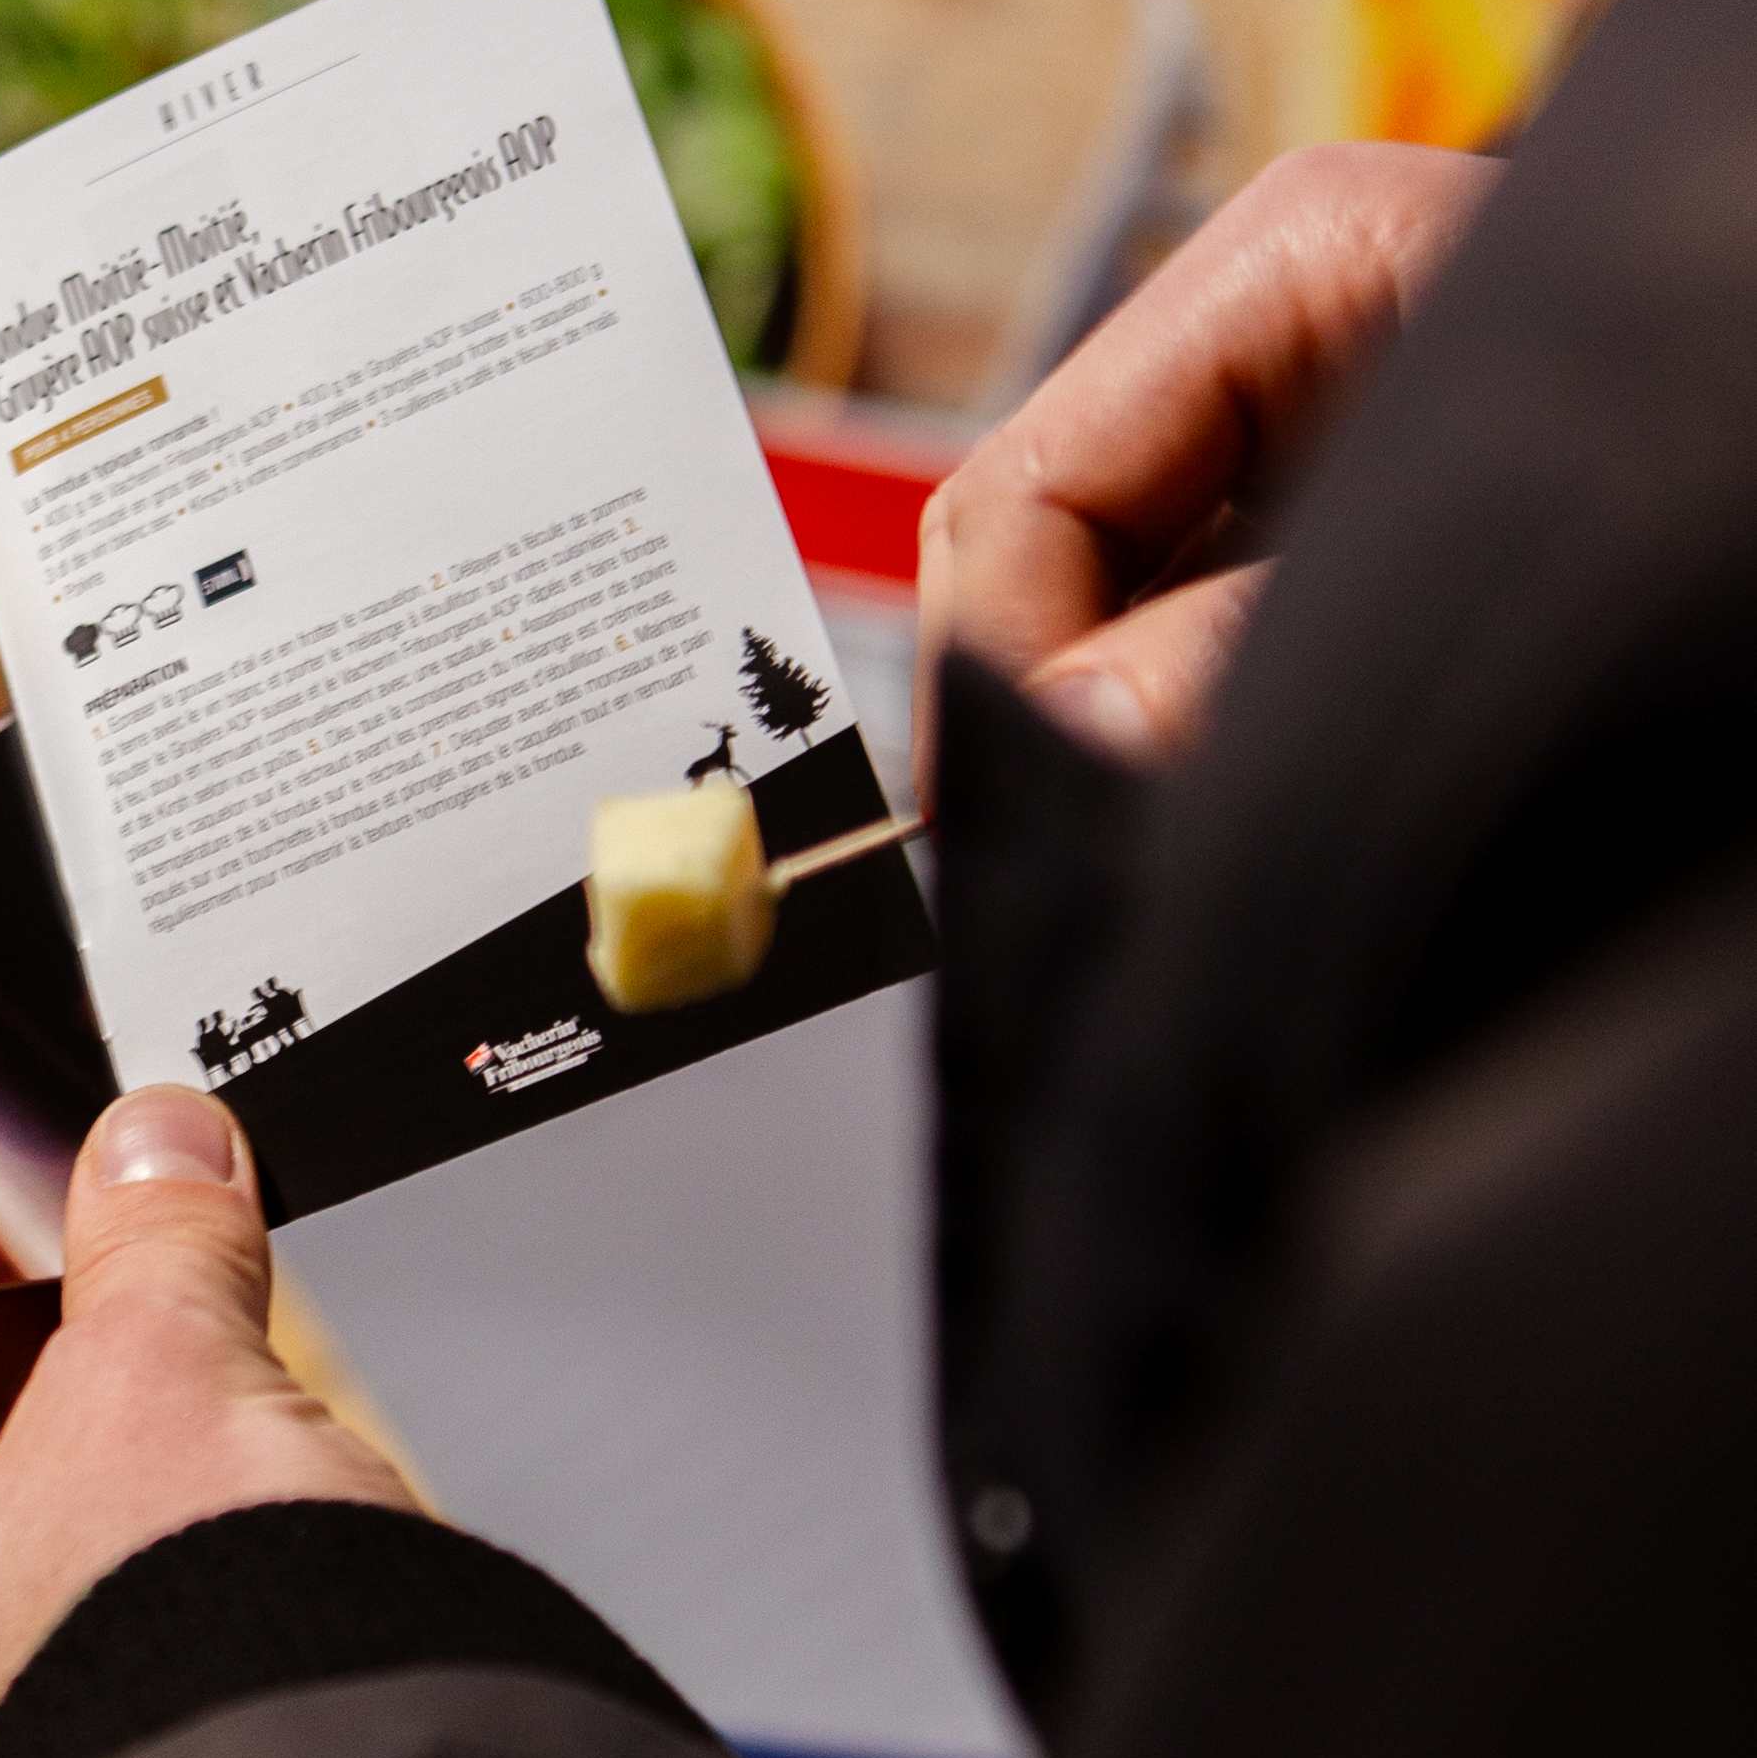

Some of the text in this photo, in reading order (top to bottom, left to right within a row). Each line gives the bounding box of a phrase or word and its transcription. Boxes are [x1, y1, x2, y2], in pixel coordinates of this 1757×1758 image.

[161, 61, 265, 133] HIVER
[58, 198, 260, 313] Moitié-Moitié,
[83, 312, 138, 376] AOP
[142, 287, 215, 346] suisse
[211, 275, 245, 314] et
[233, 225, 349, 302] Vacherin
[344, 156, 503, 253] Fribourgeois
[498, 113, 561, 181] AOP
[85, 657, 189, 715] PRÉPARATION
